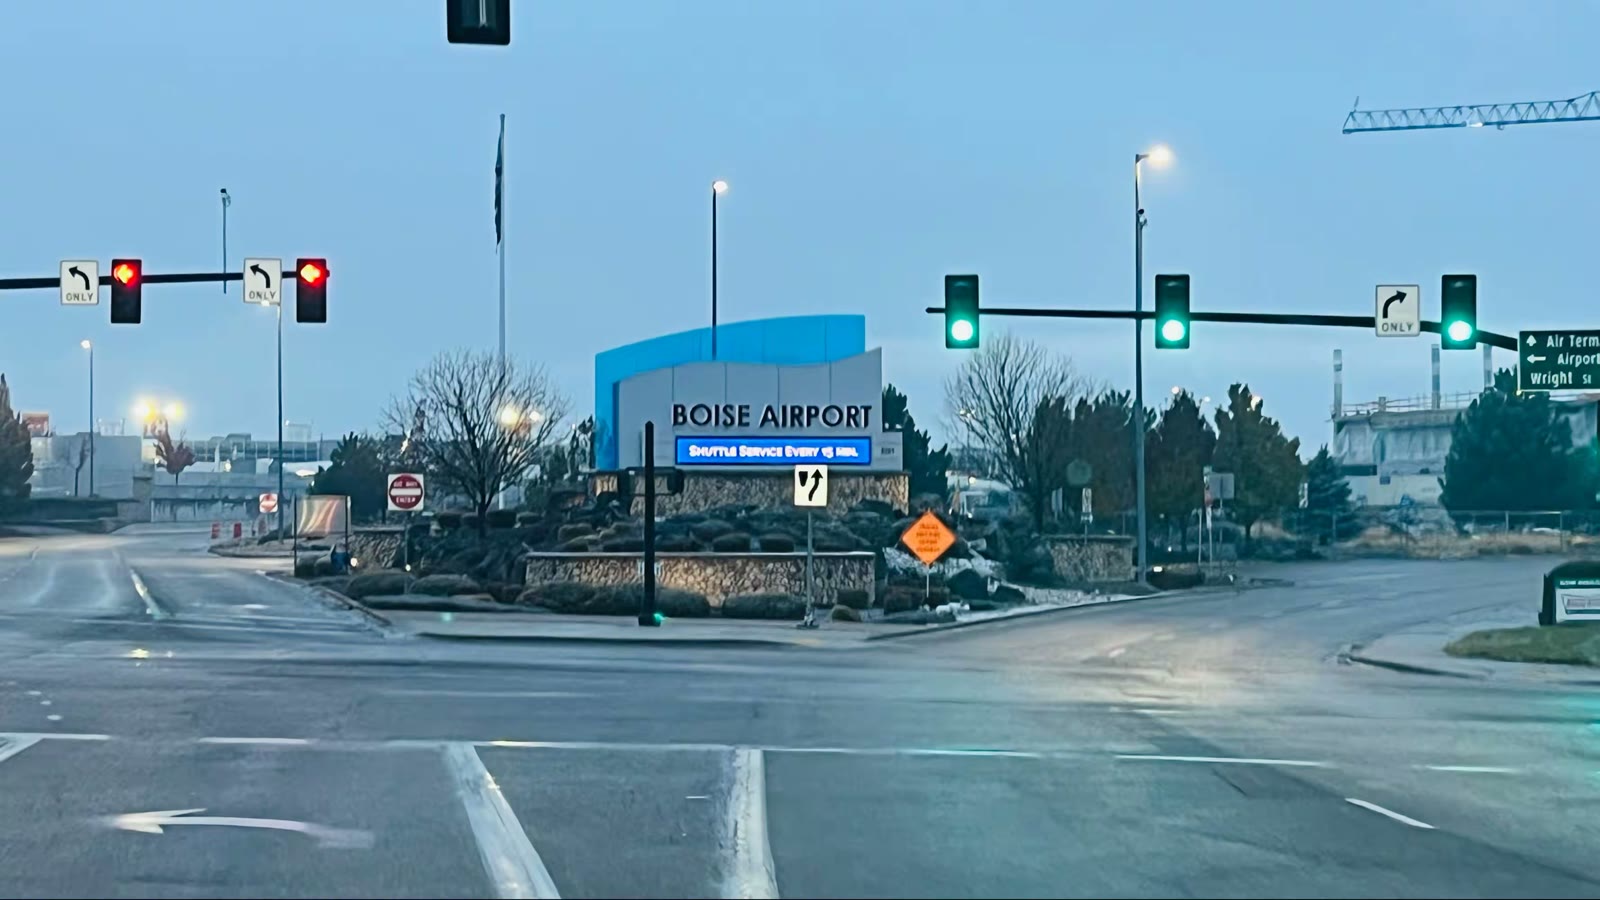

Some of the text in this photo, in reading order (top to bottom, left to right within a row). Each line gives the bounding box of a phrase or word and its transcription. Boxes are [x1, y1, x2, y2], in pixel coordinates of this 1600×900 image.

[66, 292, 93, 301] ONLY
[249, 290, 276, 300] ONLY
[1382, 322, 1413, 332] ONLY
[1546, 334, 1600, 347] Air Term
[1530, 371, 1573, 388] Wright
[672, 403, 872, 428] BOISE AIRPORT
